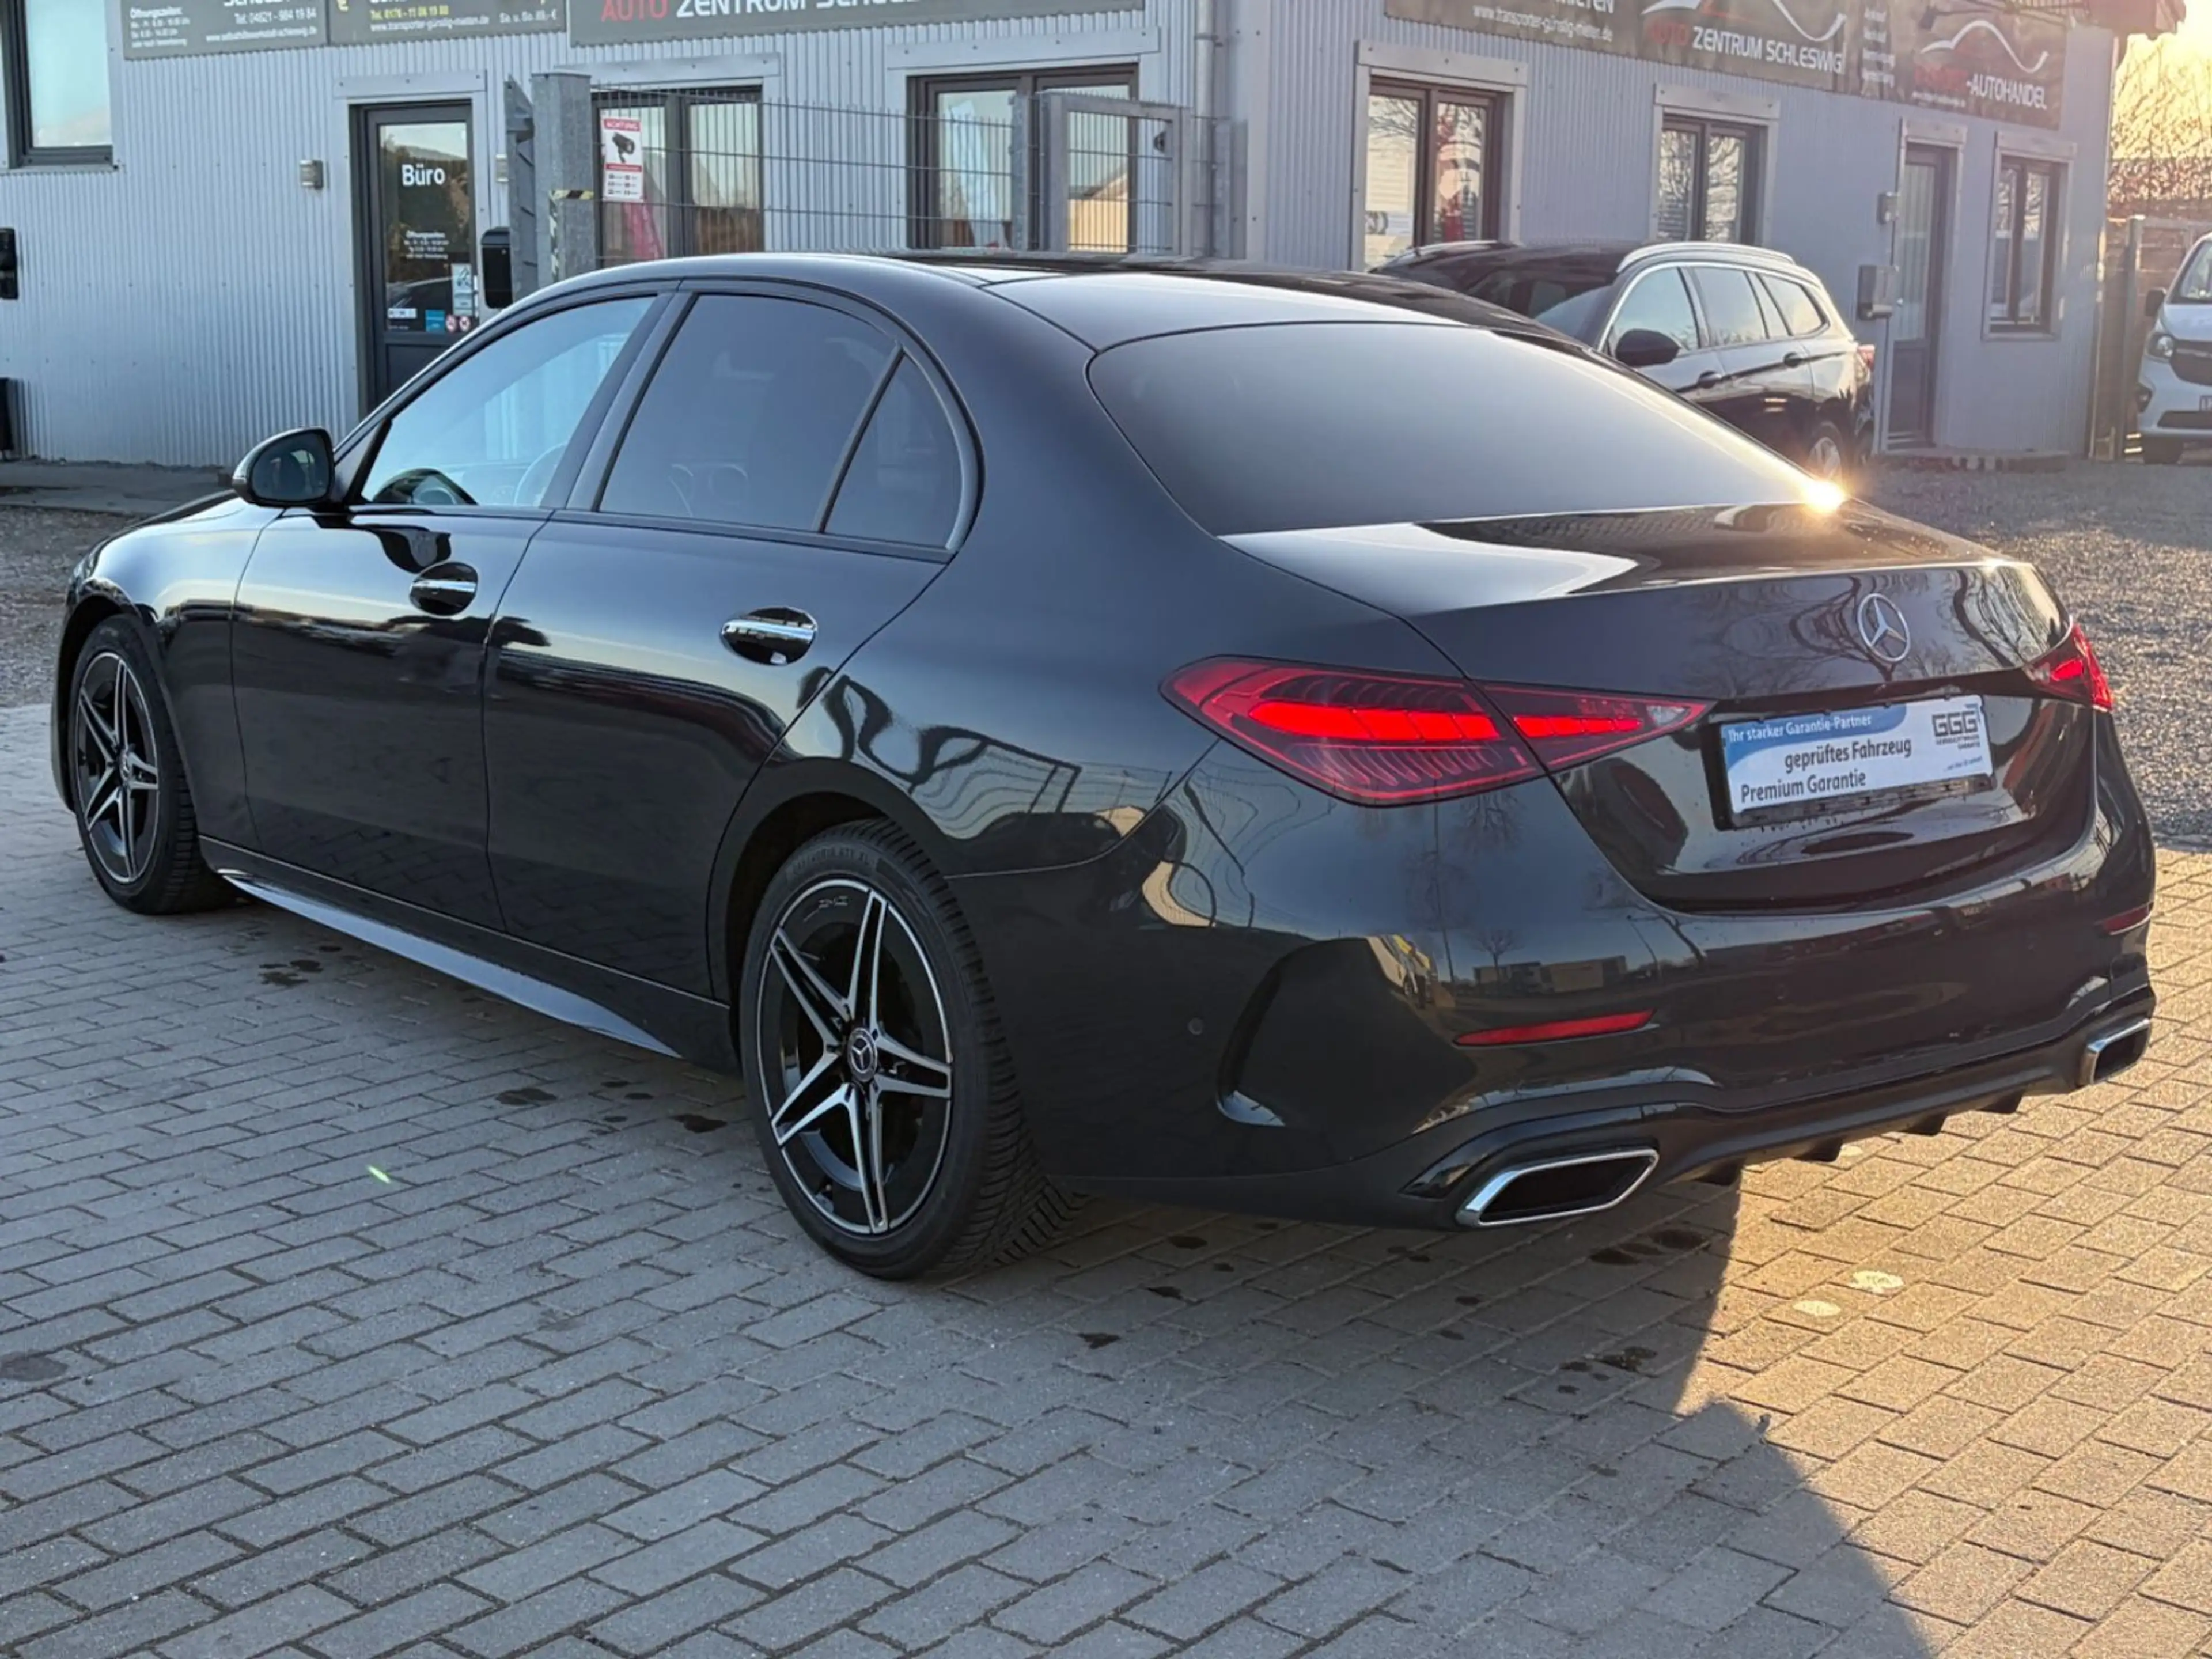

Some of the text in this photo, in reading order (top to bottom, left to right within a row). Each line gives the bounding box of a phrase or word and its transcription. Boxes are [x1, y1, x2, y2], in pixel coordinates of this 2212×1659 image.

[601, 0, 669, 22] AUTO
[1692, 26, 1762, 60] ZENTRUM
[1766, 41, 1844, 74] SCHLESWIG
[402, 163, 445, 186] Büro
[1729, 715, 1872, 742] Ihr starker Garantie-Partner
[1932, 711, 1978, 737] GGG
[1785, 738, 1912, 774] geprüftes Fahrzeug
[1741, 768, 1866, 803] Premium Garantie
